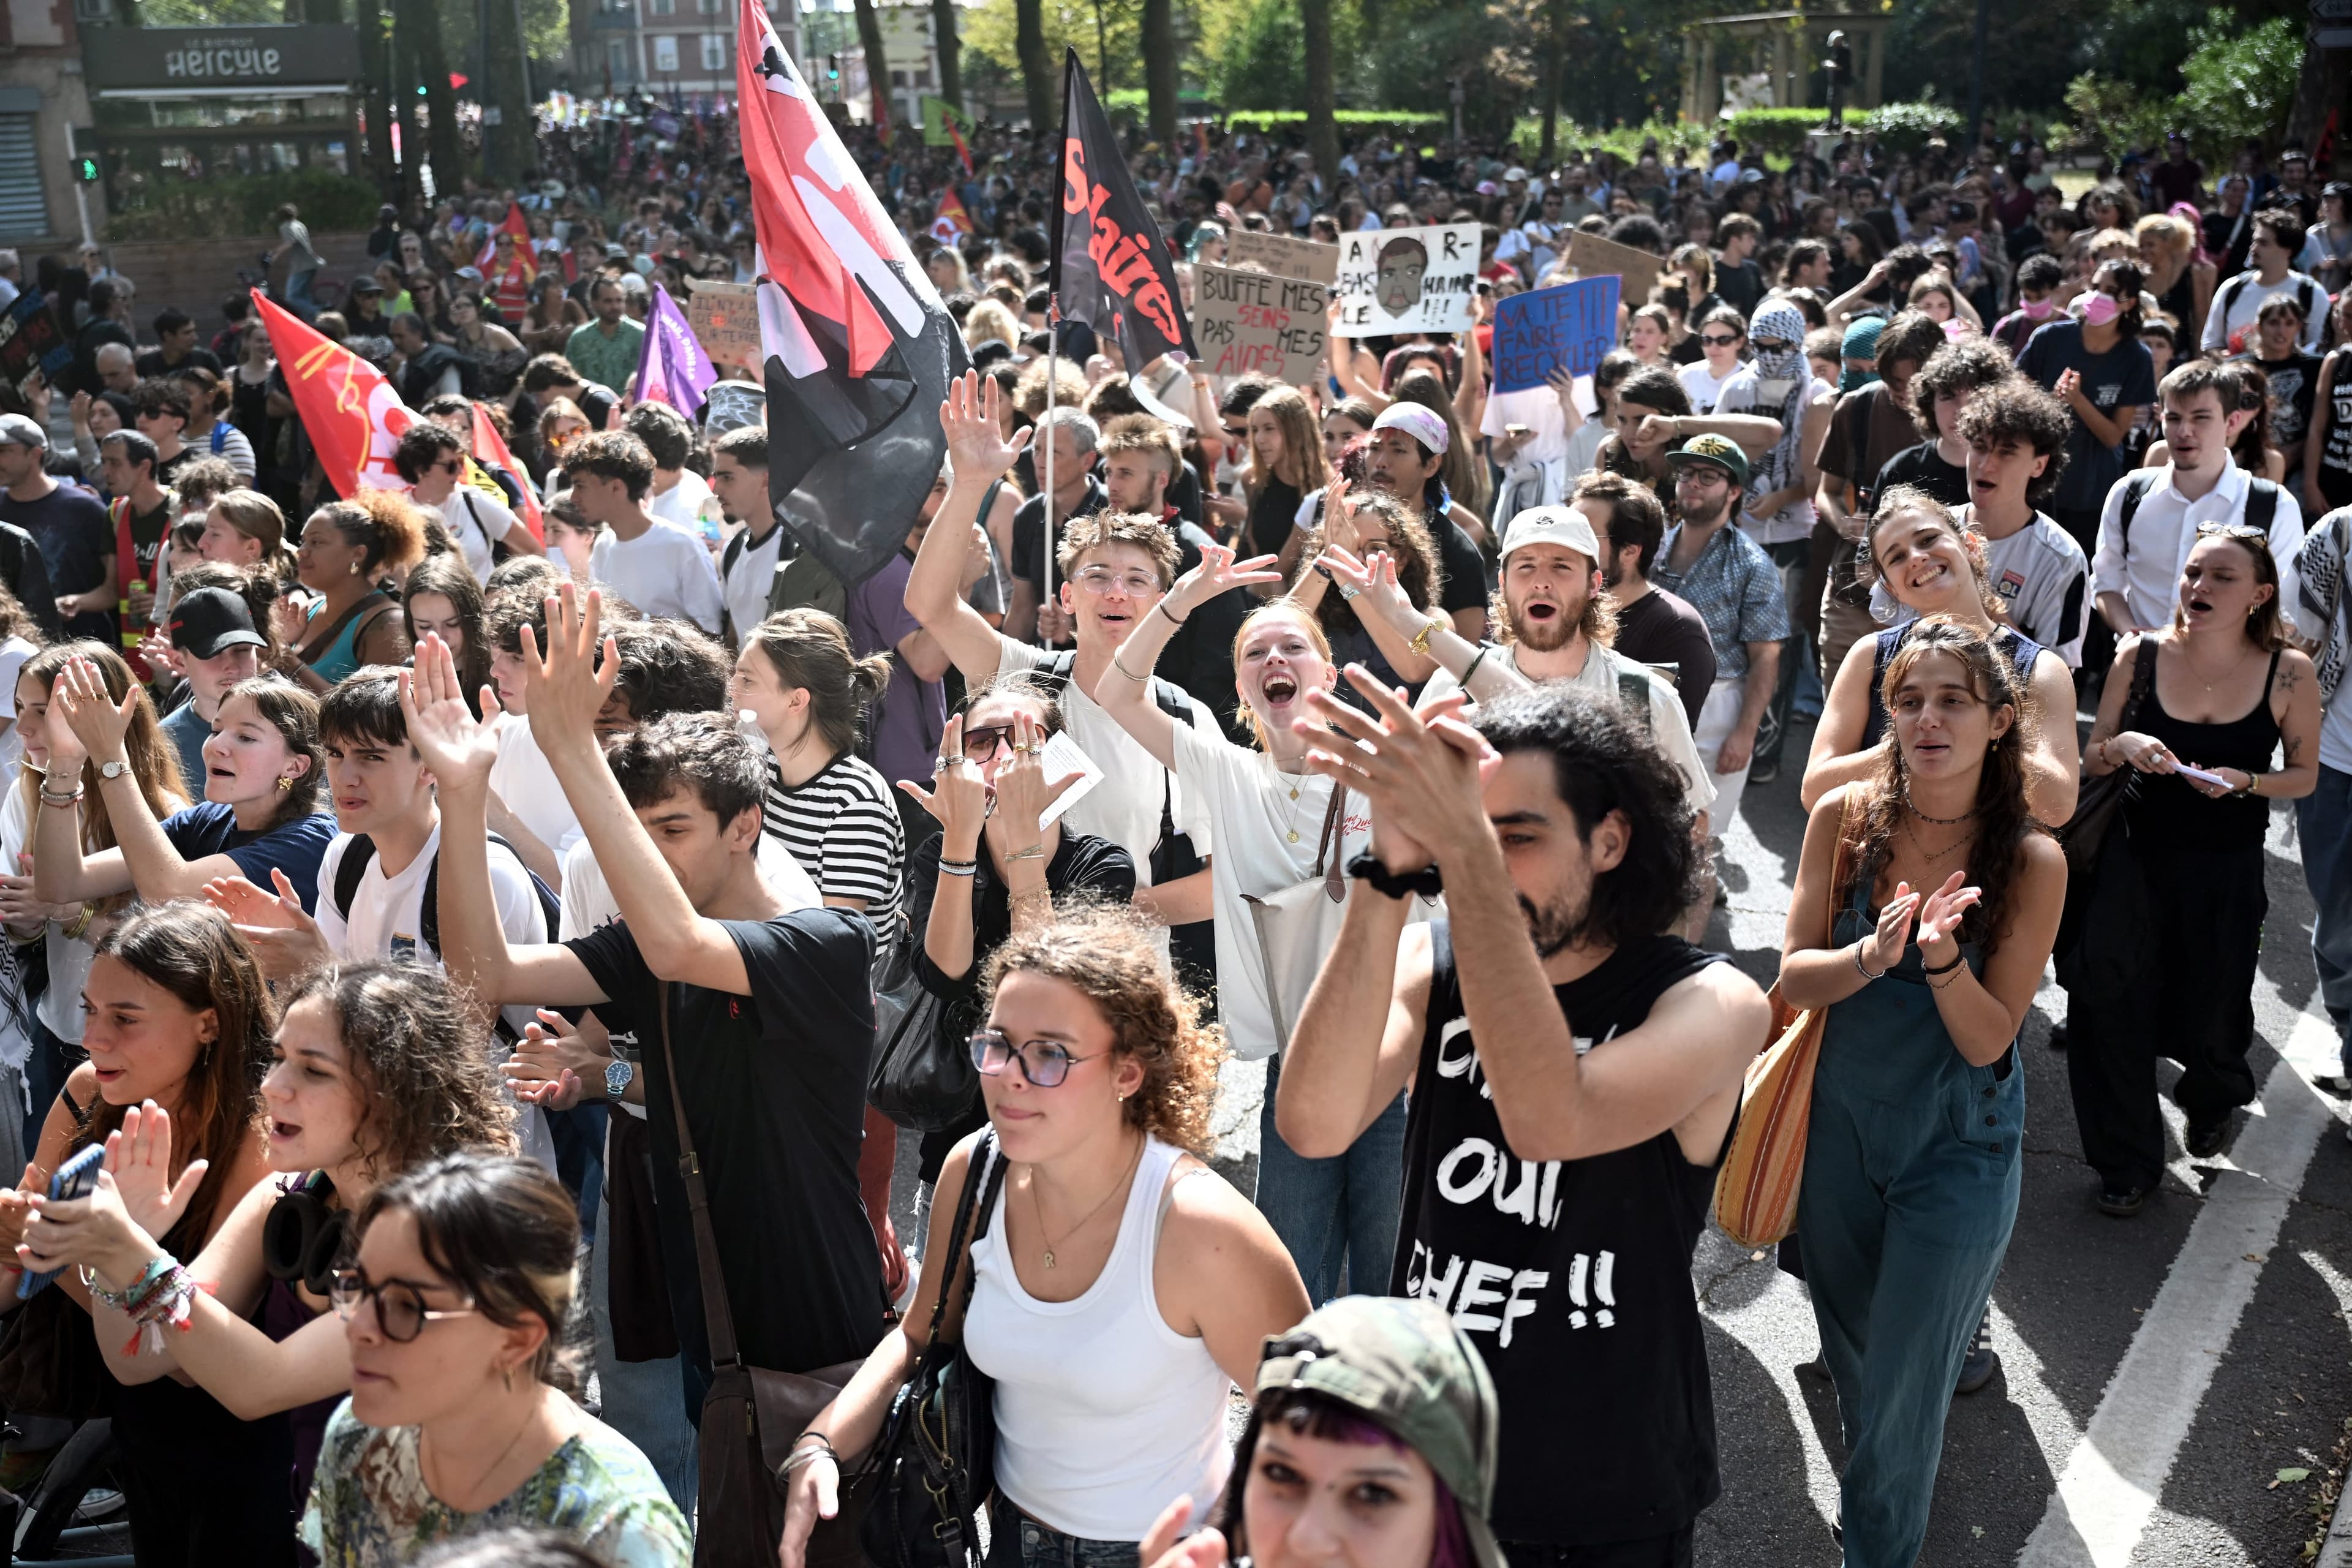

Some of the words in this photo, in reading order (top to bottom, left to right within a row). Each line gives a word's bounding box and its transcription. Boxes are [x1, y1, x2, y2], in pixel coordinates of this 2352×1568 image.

[1349, 240, 1363, 263] A
[1202, 270, 1273, 307] BOUFFE
[1281, 282, 1324, 315] MES
[1501, 301, 1531, 330] VA
[1538, 292, 1572, 322] TE
[1237, 304, 1291, 330] SEINS
[1342, 305, 1371, 325] LE
[1201, 318, 1236, 345] PAS
[1275, 328, 1324, 356] MES
[1499, 322, 1567, 354] FAIRE
[1500, 335, 1610, 386] RECYCLER
[1406, 1238, 1550, 1349] CHEF
